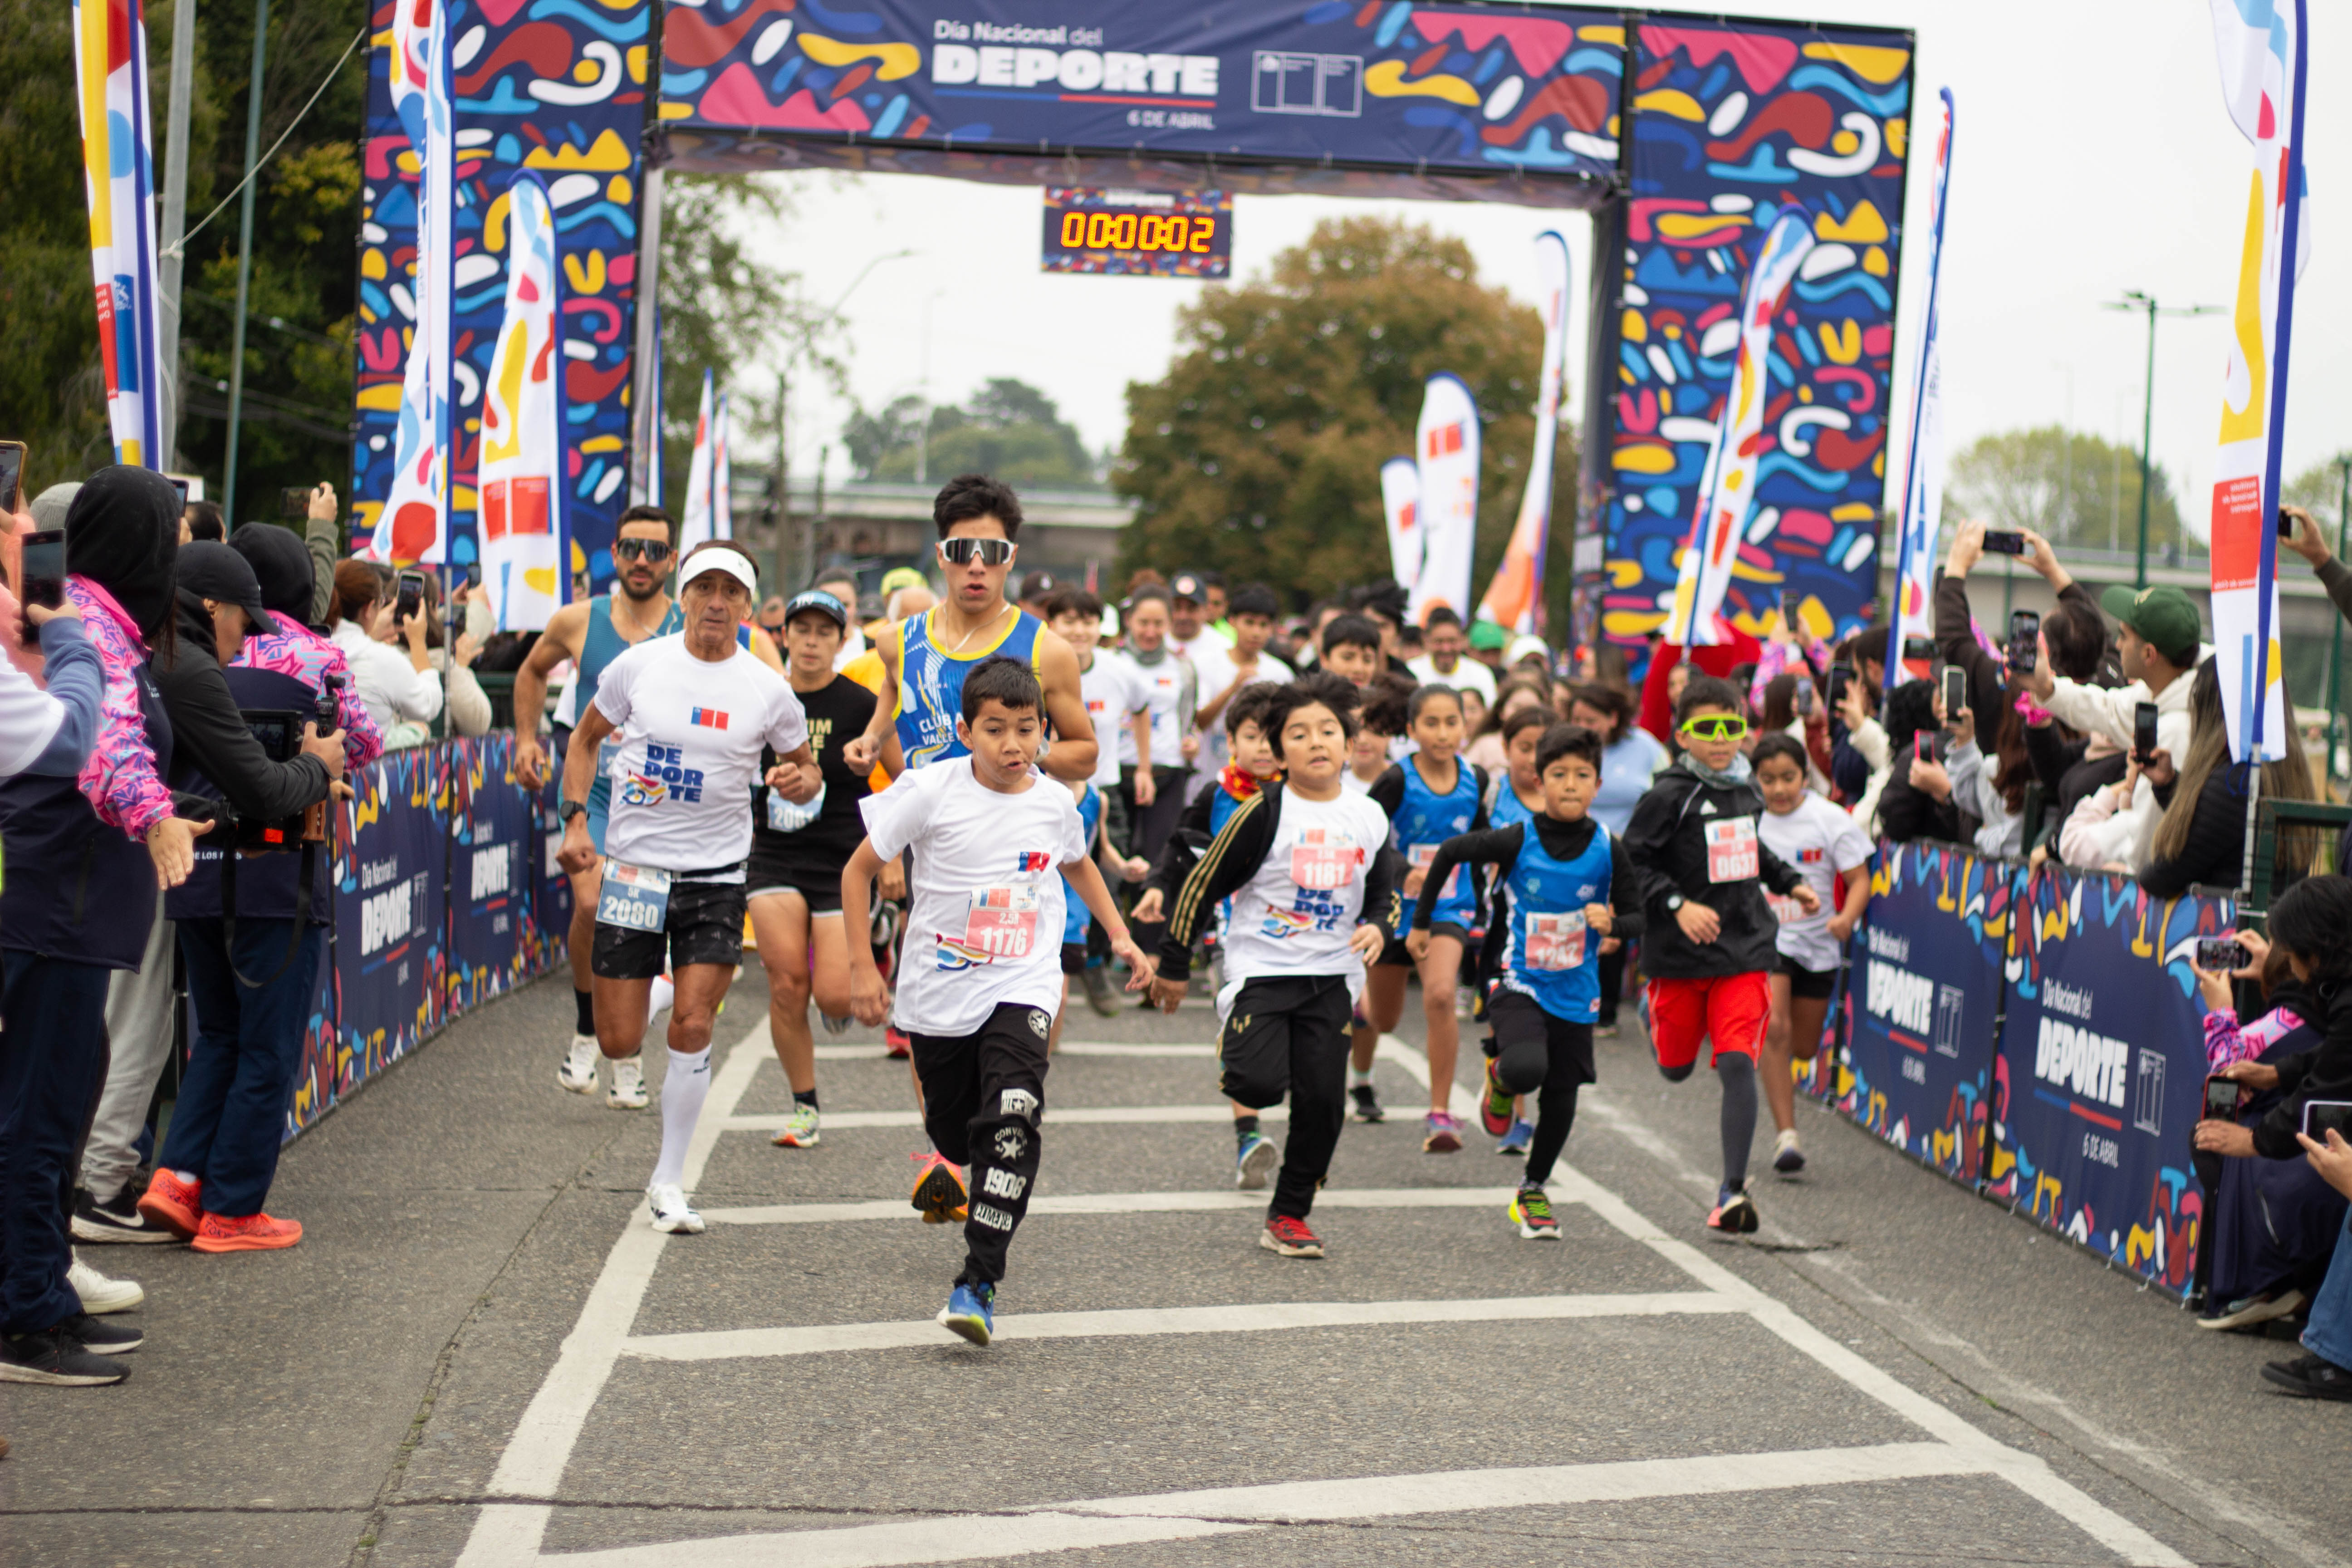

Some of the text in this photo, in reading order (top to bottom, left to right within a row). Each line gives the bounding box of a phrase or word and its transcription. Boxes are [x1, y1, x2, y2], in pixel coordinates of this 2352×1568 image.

[934, 20, 1103, 46] Día Nacional del
[931, 44, 1219, 96] DEPORTE
[1127, 110, 1215, 130] 6 DE ABRIL
[1061, 212, 1215, 253] 00:00:02
[919, 713, 952, 733] CLUB
[922, 732, 955, 745] VALLE
[647, 744, 682, 765] DE
[644, 760, 704, 786] POR
[668, 784, 702, 804] TE
[202, 851, 217, 860] LOS
[1303, 862, 1346, 887] 1181
[362, 878, 411, 956] DEPORTE
[603, 895, 659, 928] 2080
[980, 926, 1028, 956] 1176
[1867, 957, 1934, 1036] DEPORTE
[2034, 1015, 2129, 1109] DEPORTE
[984, 1166, 1027, 1200] 1908
